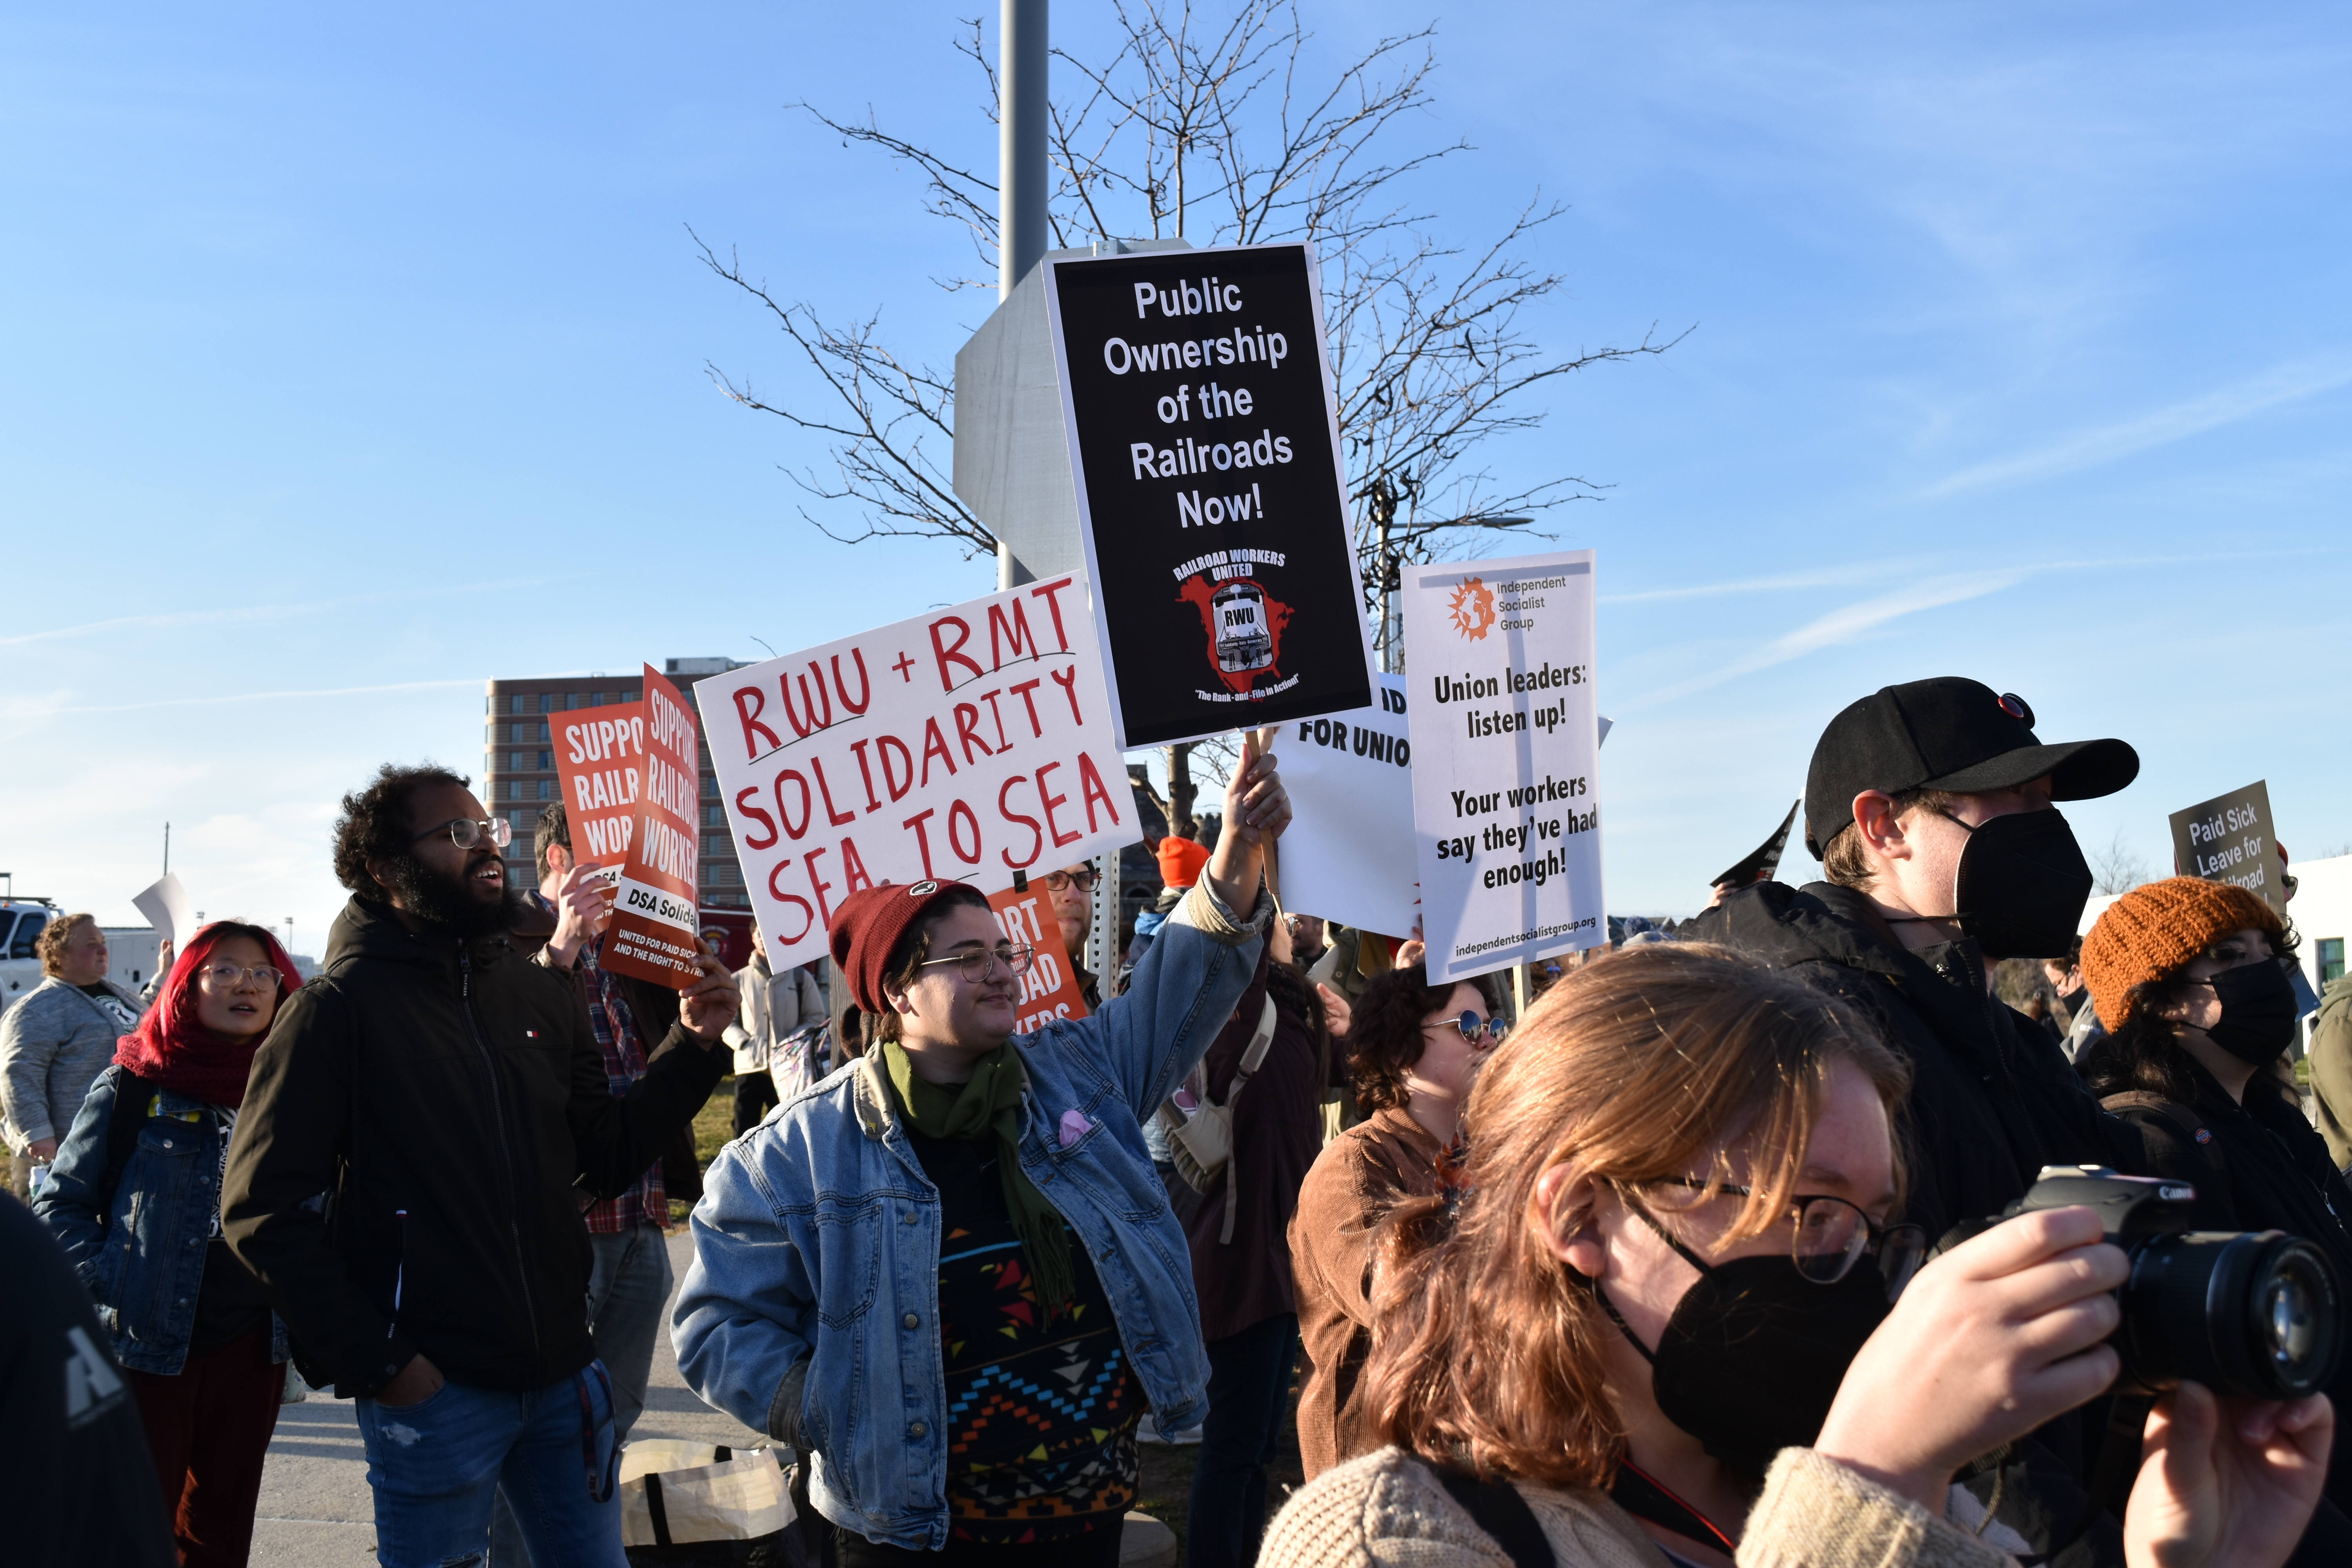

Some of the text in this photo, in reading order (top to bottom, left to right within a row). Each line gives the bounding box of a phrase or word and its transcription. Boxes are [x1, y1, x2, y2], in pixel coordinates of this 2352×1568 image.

[1134, 276, 1242, 318] Public
[1104, 325, 1287, 375] Ownership
[1157, 382, 1253, 423] of the
[1130, 429, 1293, 480] Railroads
[1177, 483, 1263, 528] Now!
[1172, 548, 1286, 582] RAILROAD WORKERS
[1212, 563, 1253, 581] UNITED
[1497, 576, 1566, 594] Independent
[1224, 607, 1254, 627] RWU
[1499, 597, 1545, 612] Socialist
[1500, 617, 1534, 632] Group
[733, 577, 1072, 759] RWU + RMT
[1434, 672, 1498, 704] Union
[1506, 662, 1586, 693] leaders:
[1266, 687, 1274, 696] in
[650, 688, 695, 776] SUPPORT
[1467, 698, 1566, 738] listen up!
[566, 716, 643, 764] SUPPO
[735, 664, 1084, 850] SOLIDARITY
[1299, 719, 1411, 768] FOR UNIO
[573, 768, 639, 811] RAILR
[647, 753, 698, 835] RAILROAD
[1451, 775, 1586, 818] Your workers
[903, 799, 982, 879] TO
[998, 751, 1120, 869] SEA
[1437, 803, 1597, 864] say they’ve had
[2189, 803, 2257, 846] Paid Sick
[1484, 848, 1566, 889] enough!
[2196, 837, 2261, 877] Leave for
[628, 889, 657, 912] DSA
[613, 942, 632, 955] AND
[633, 947, 648, 960] THE
[648, 954, 673, 968] RIGHT
[673, 960, 684, 971] TO
[619, 929, 646, 945] UNITED
[646, 937, 660, 949] FOR
[661, 942, 679, 955] PAID
[1456, 917, 1596, 956] independentsocialistgroup.org
[2159, 1186, 2193, 1200] Canon
